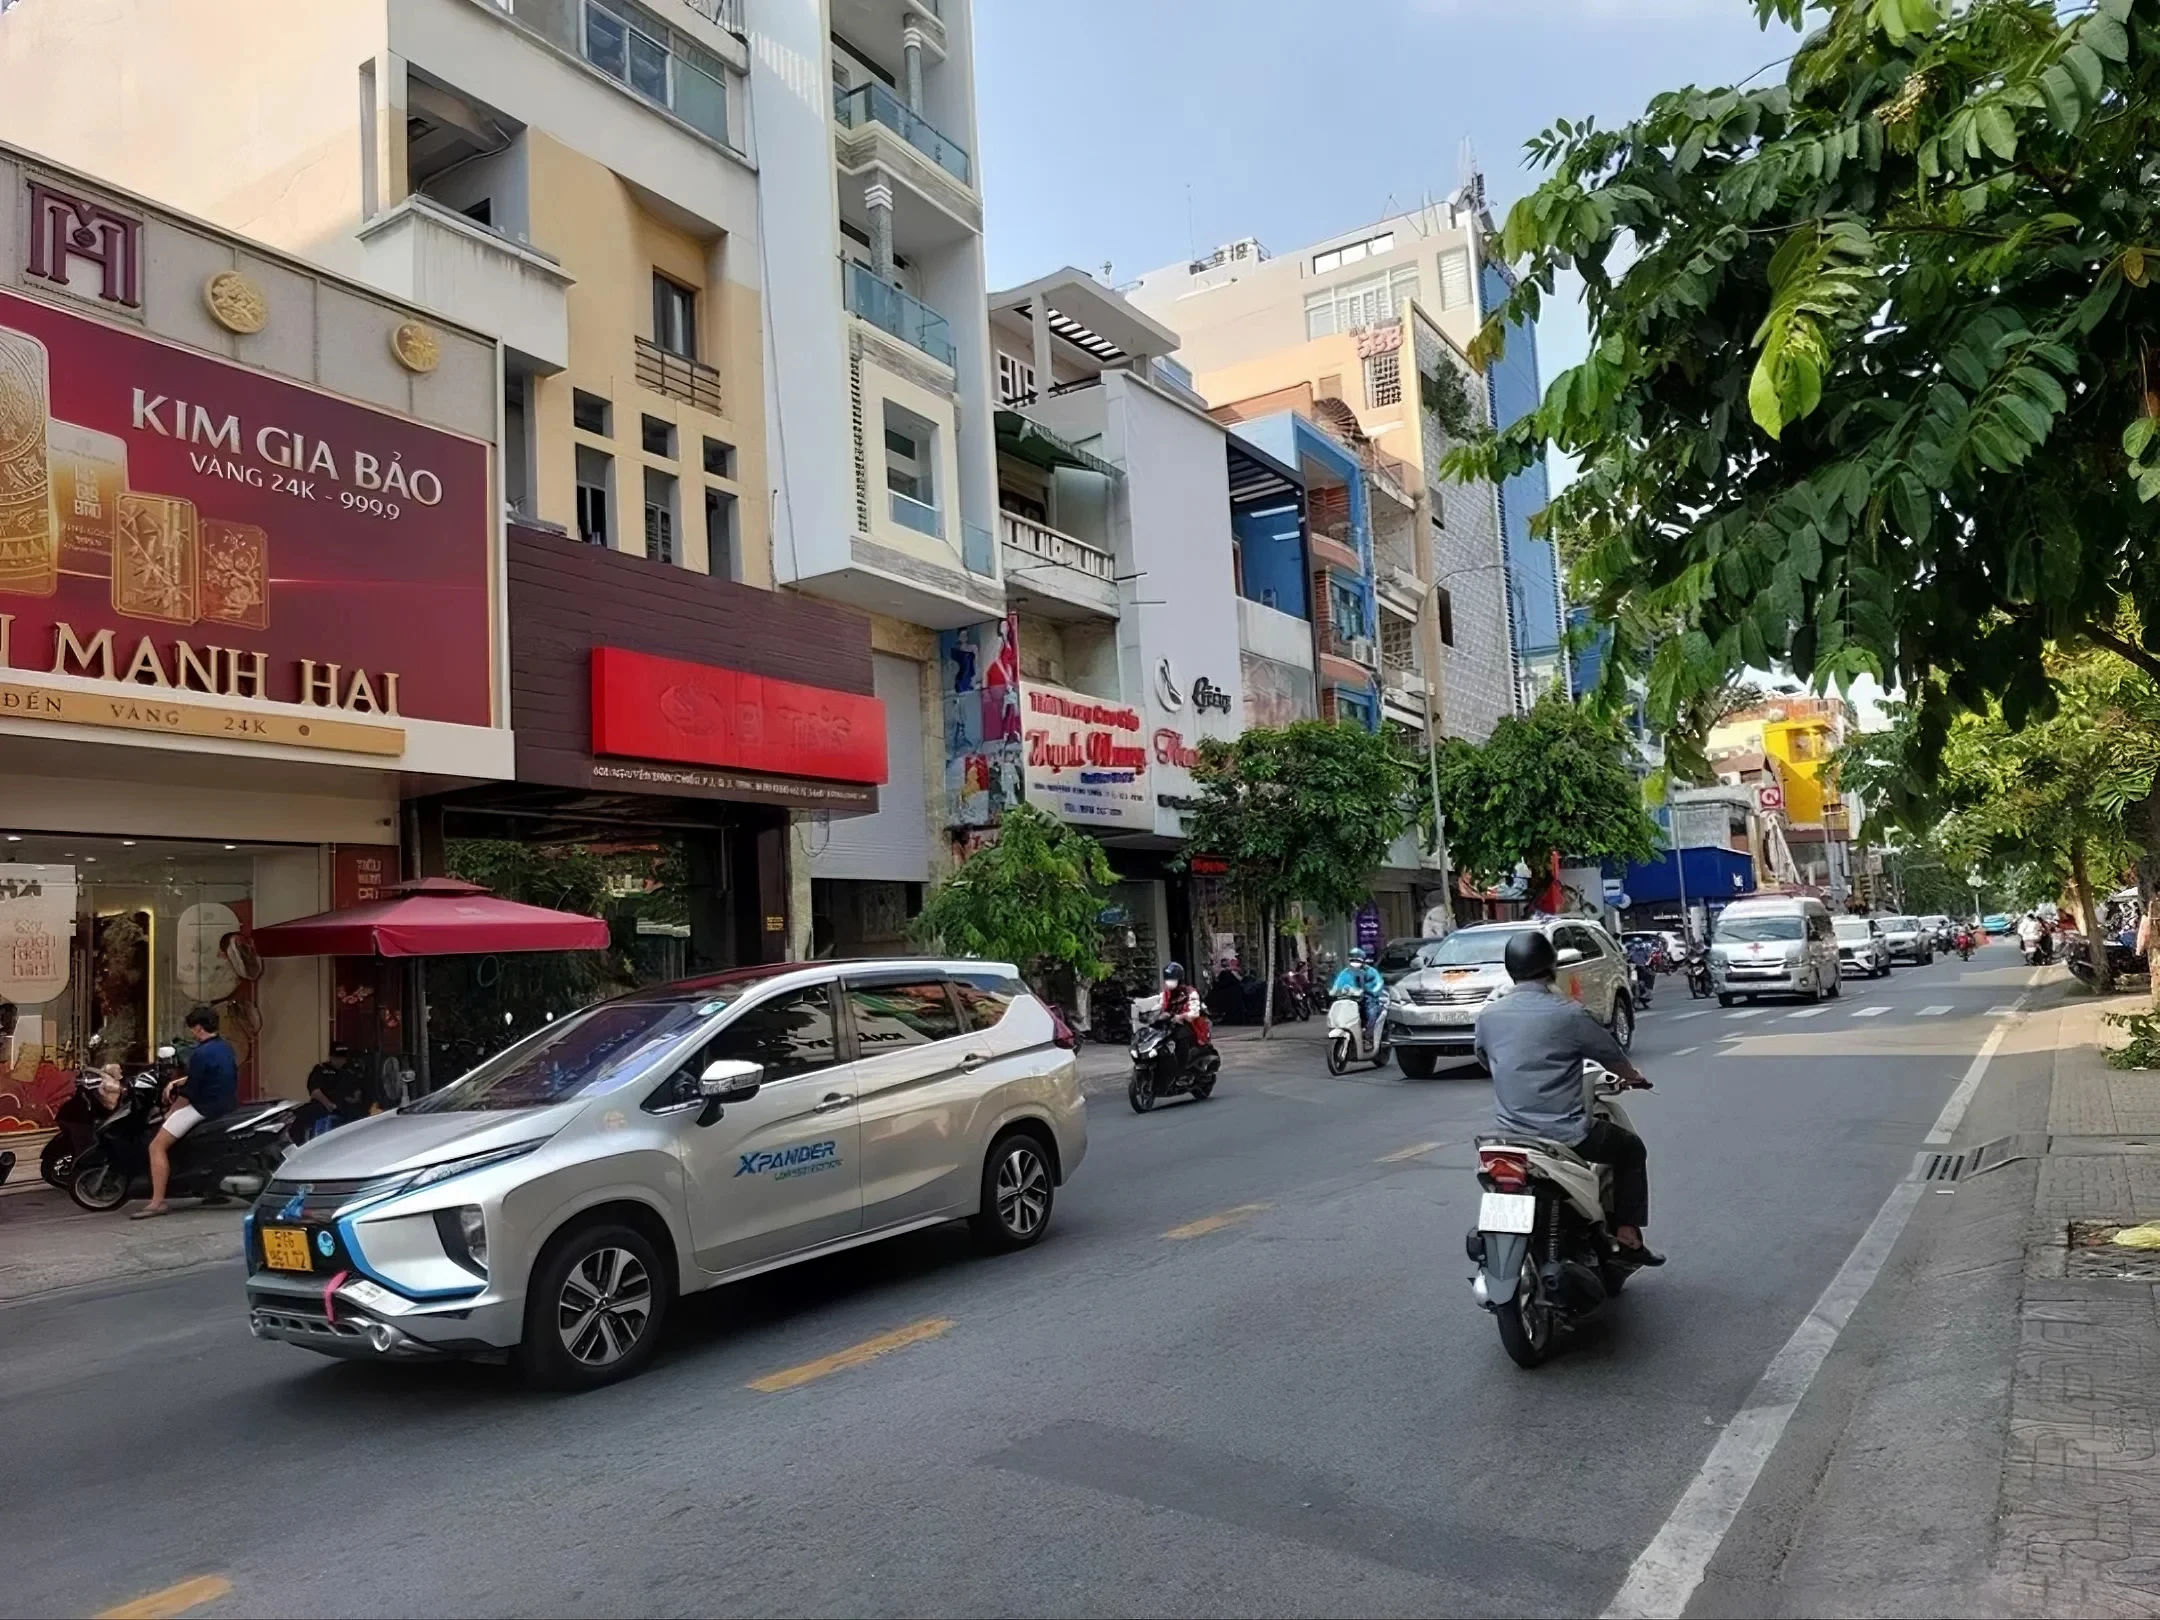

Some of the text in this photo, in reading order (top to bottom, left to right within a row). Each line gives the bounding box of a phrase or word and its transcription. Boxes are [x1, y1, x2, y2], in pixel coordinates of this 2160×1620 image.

[132, 387, 444, 506] KIM GIA BẢO
[189, 452, 264, 488] VÀNG
[271, 473, 317, 501] 24K
[340, 492, 401, 521] 999.9
[224, 717, 268, 735] 24K
[732, 1140, 837, 1178] XPANDER
